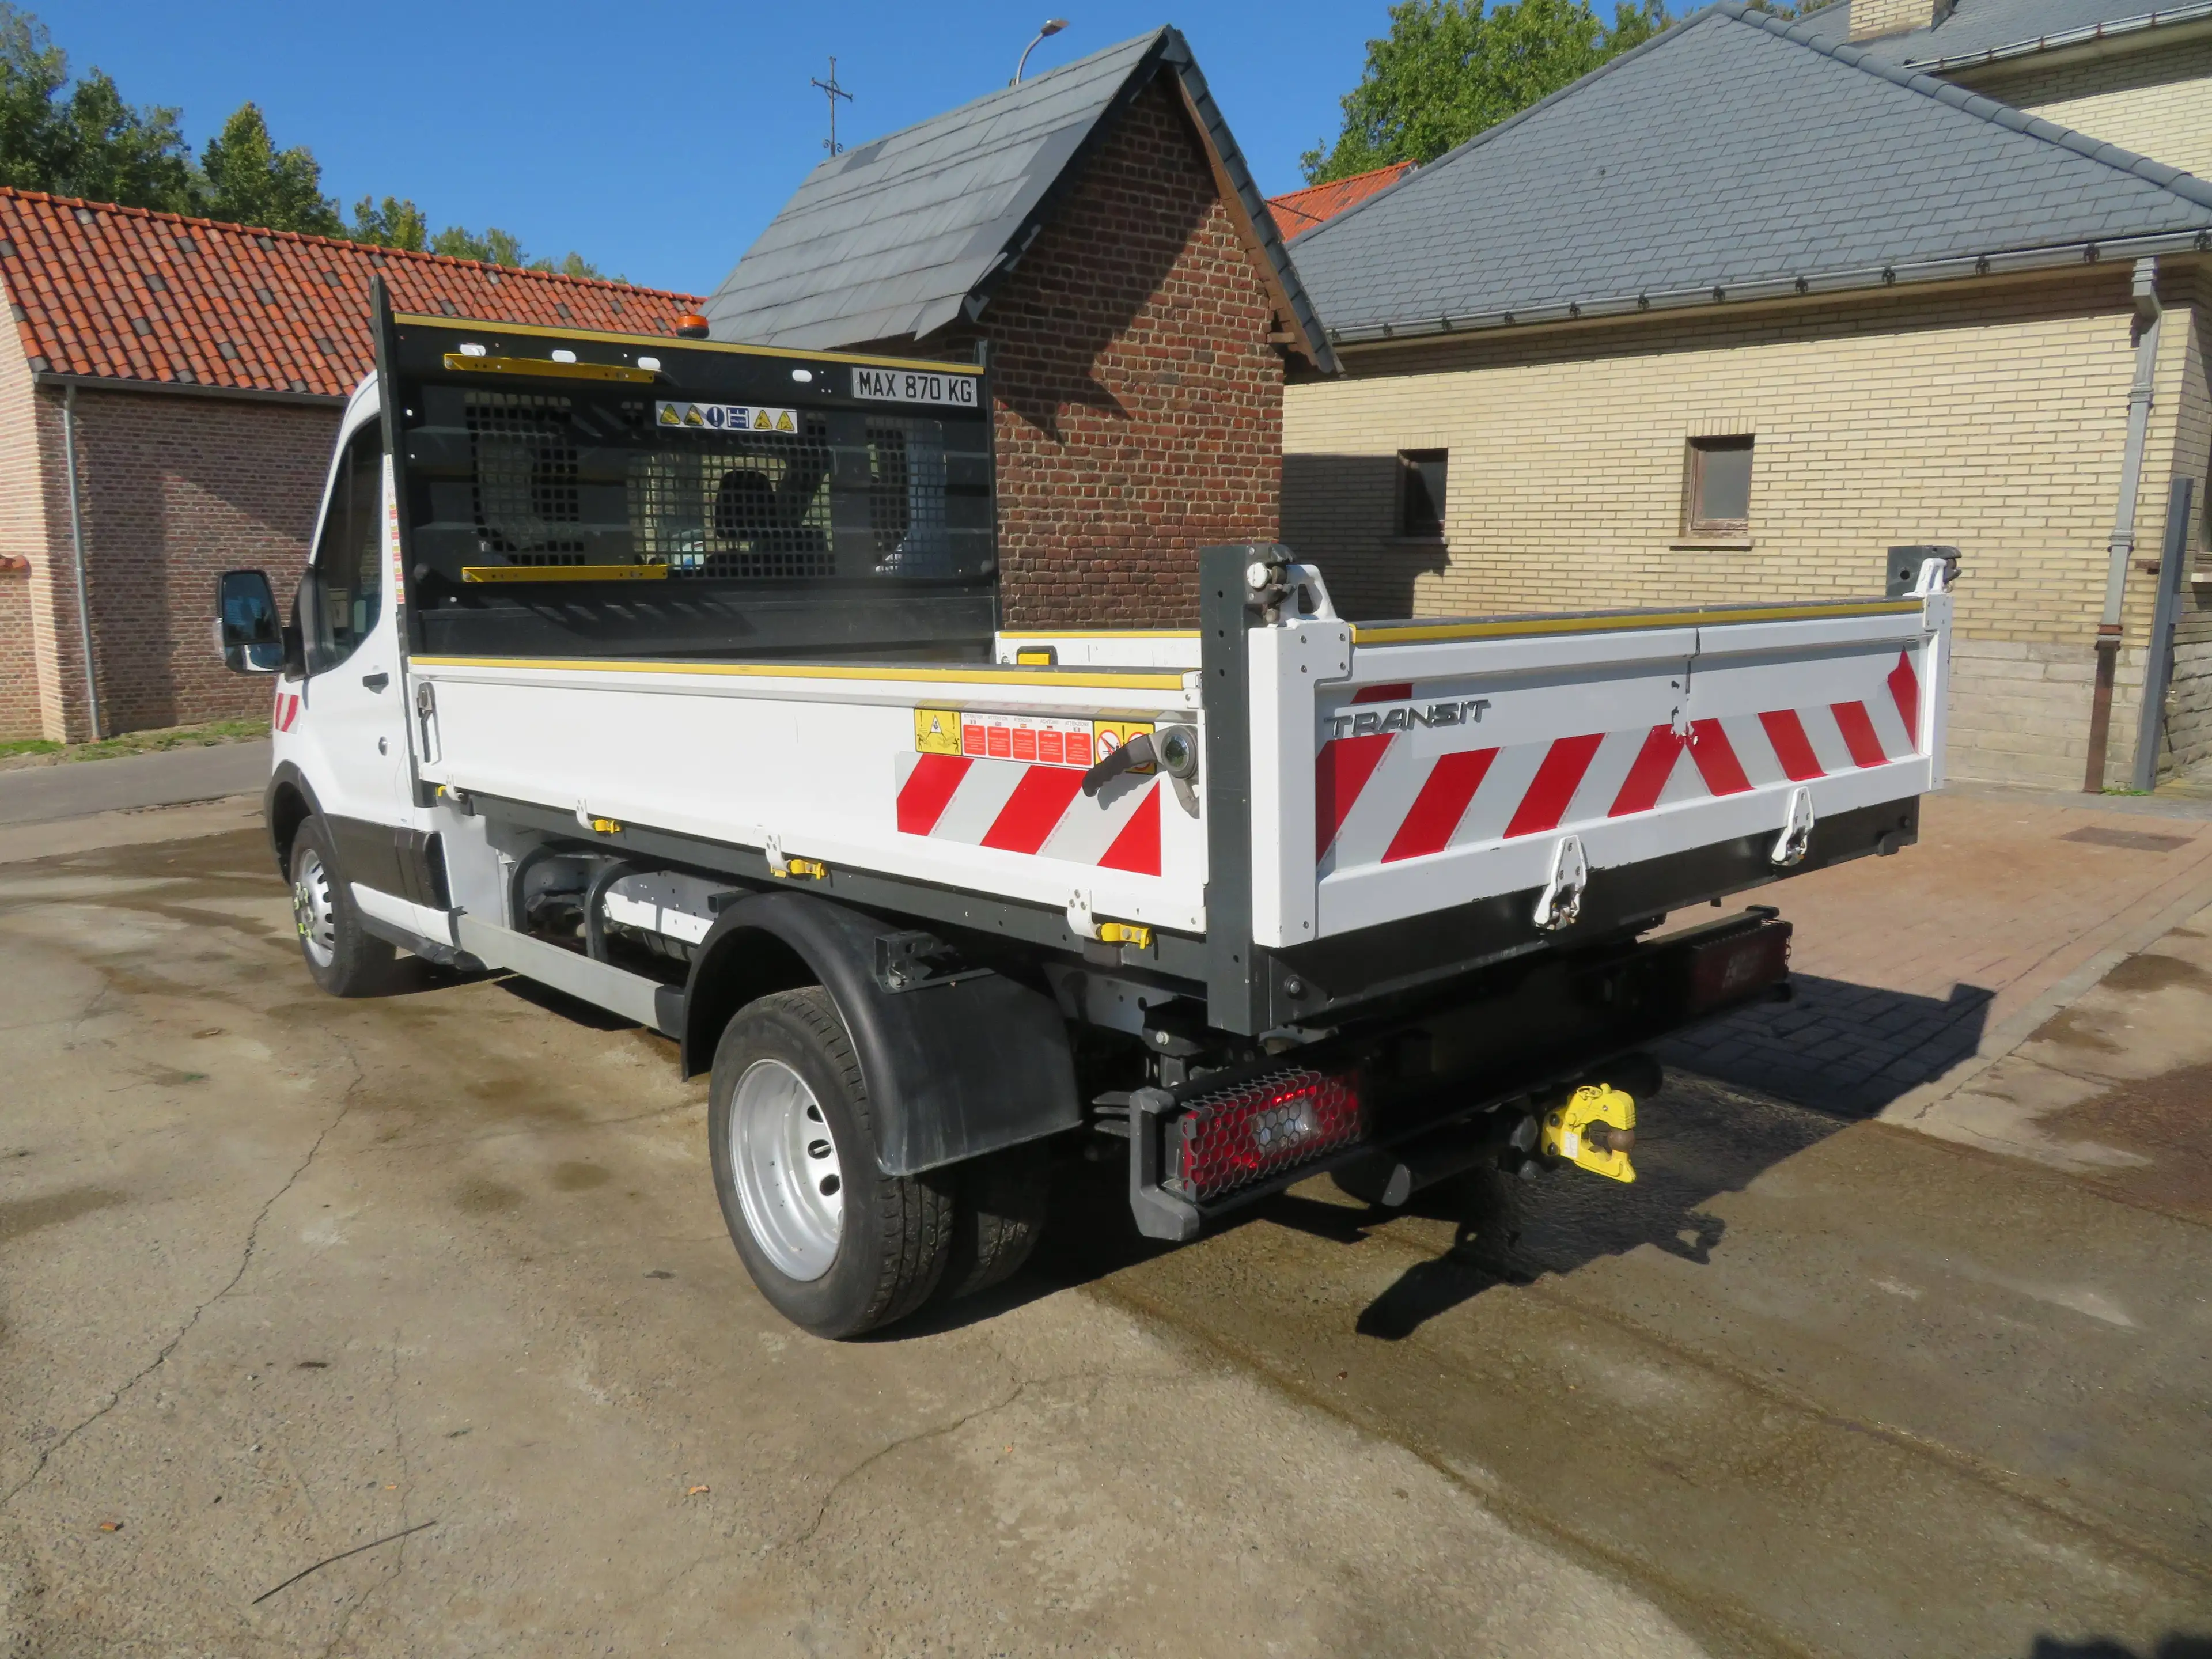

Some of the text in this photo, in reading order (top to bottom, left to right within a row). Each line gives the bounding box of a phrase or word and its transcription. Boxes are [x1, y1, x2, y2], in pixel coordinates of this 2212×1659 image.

[859, 370, 972, 403] MAX 870 KG
[1323, 699, 1490, 737] TRANSIT
